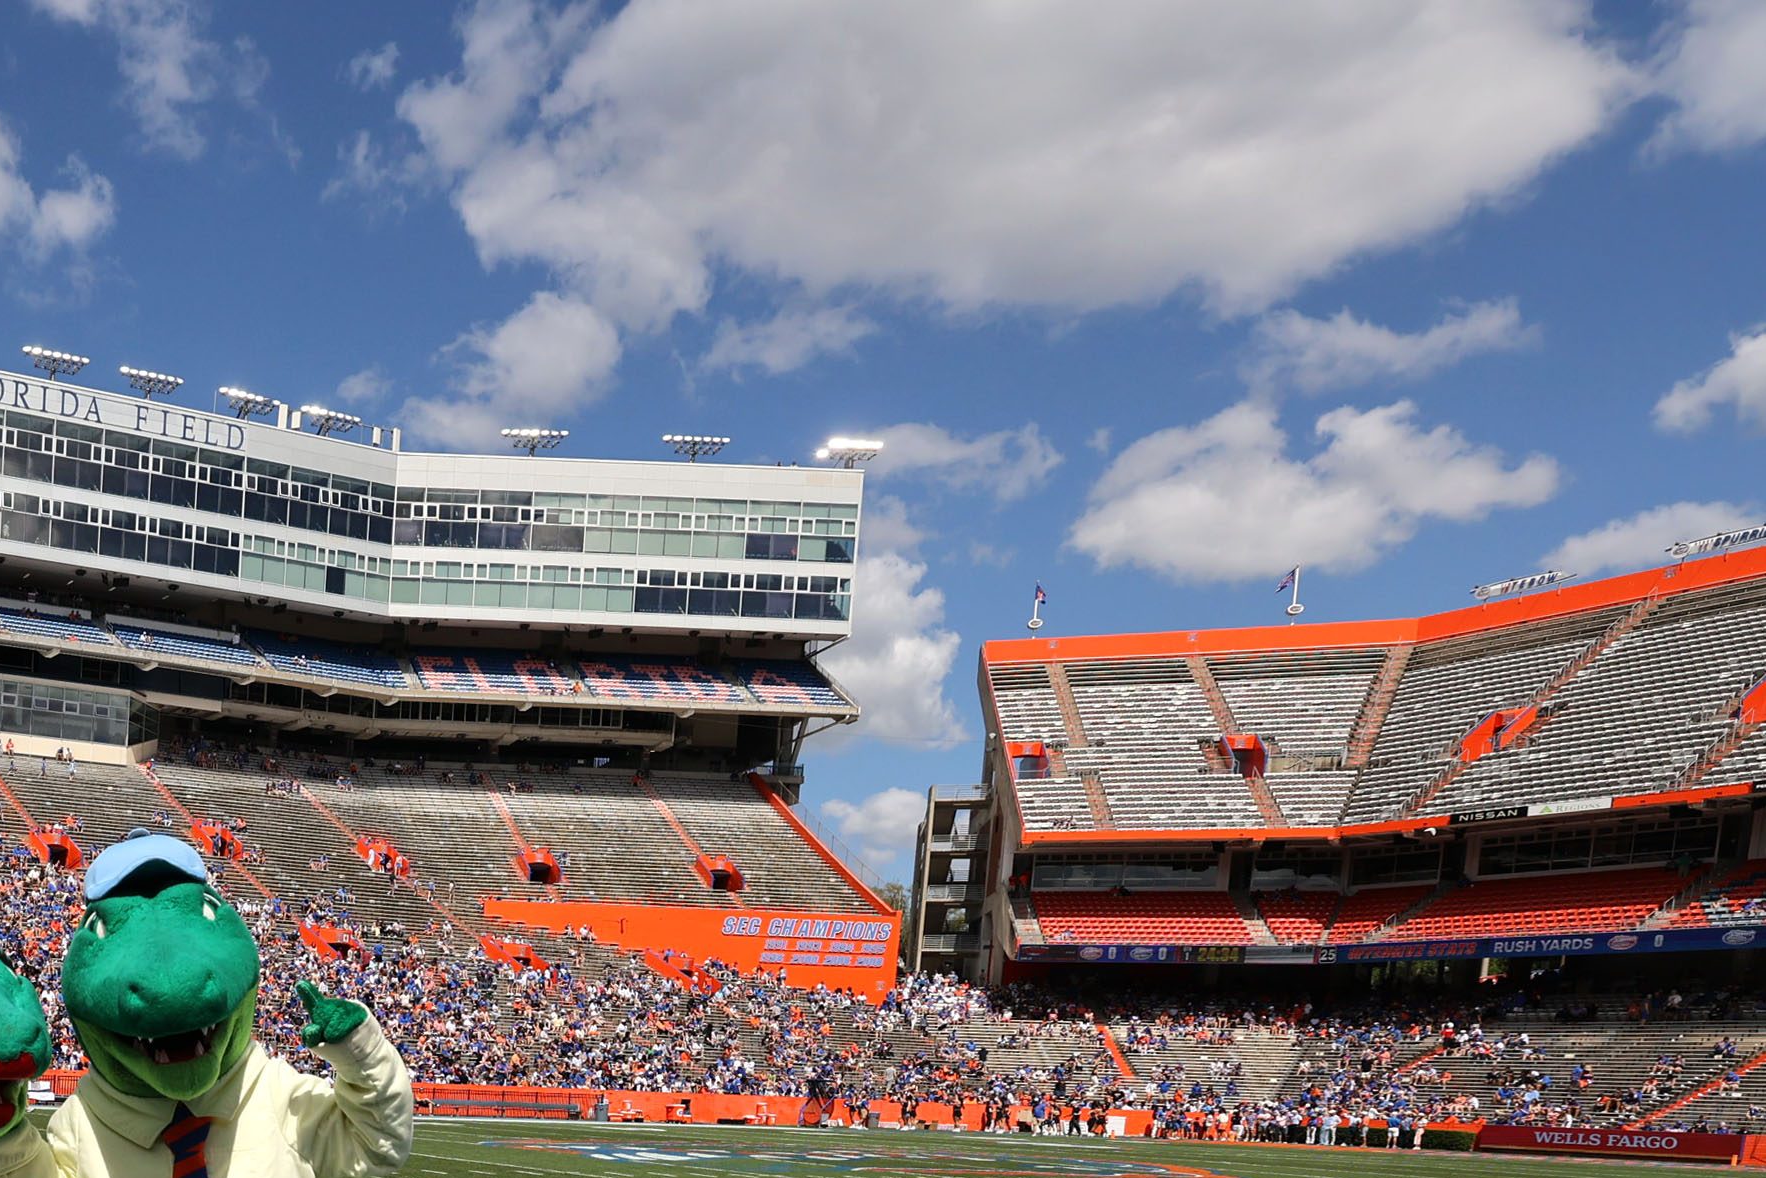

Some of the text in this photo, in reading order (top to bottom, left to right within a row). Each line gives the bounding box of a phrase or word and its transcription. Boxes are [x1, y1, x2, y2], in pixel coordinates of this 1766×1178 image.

[134, 406, 247, 450] FIELD
[1511, 573, 1559, 591] TEBOW
[1459, 809, 1519, 822] NISSAN
[722, 916, 892, 941] SEC CHAMPIONS
[1428, 941, 1477, 956] STATS
[1493, 937, 1594, 954] RUSH YARDS
[1320, 949, 1335, 961] 25
[1534, 1131, 1678, 1149] WELLS FARGO
